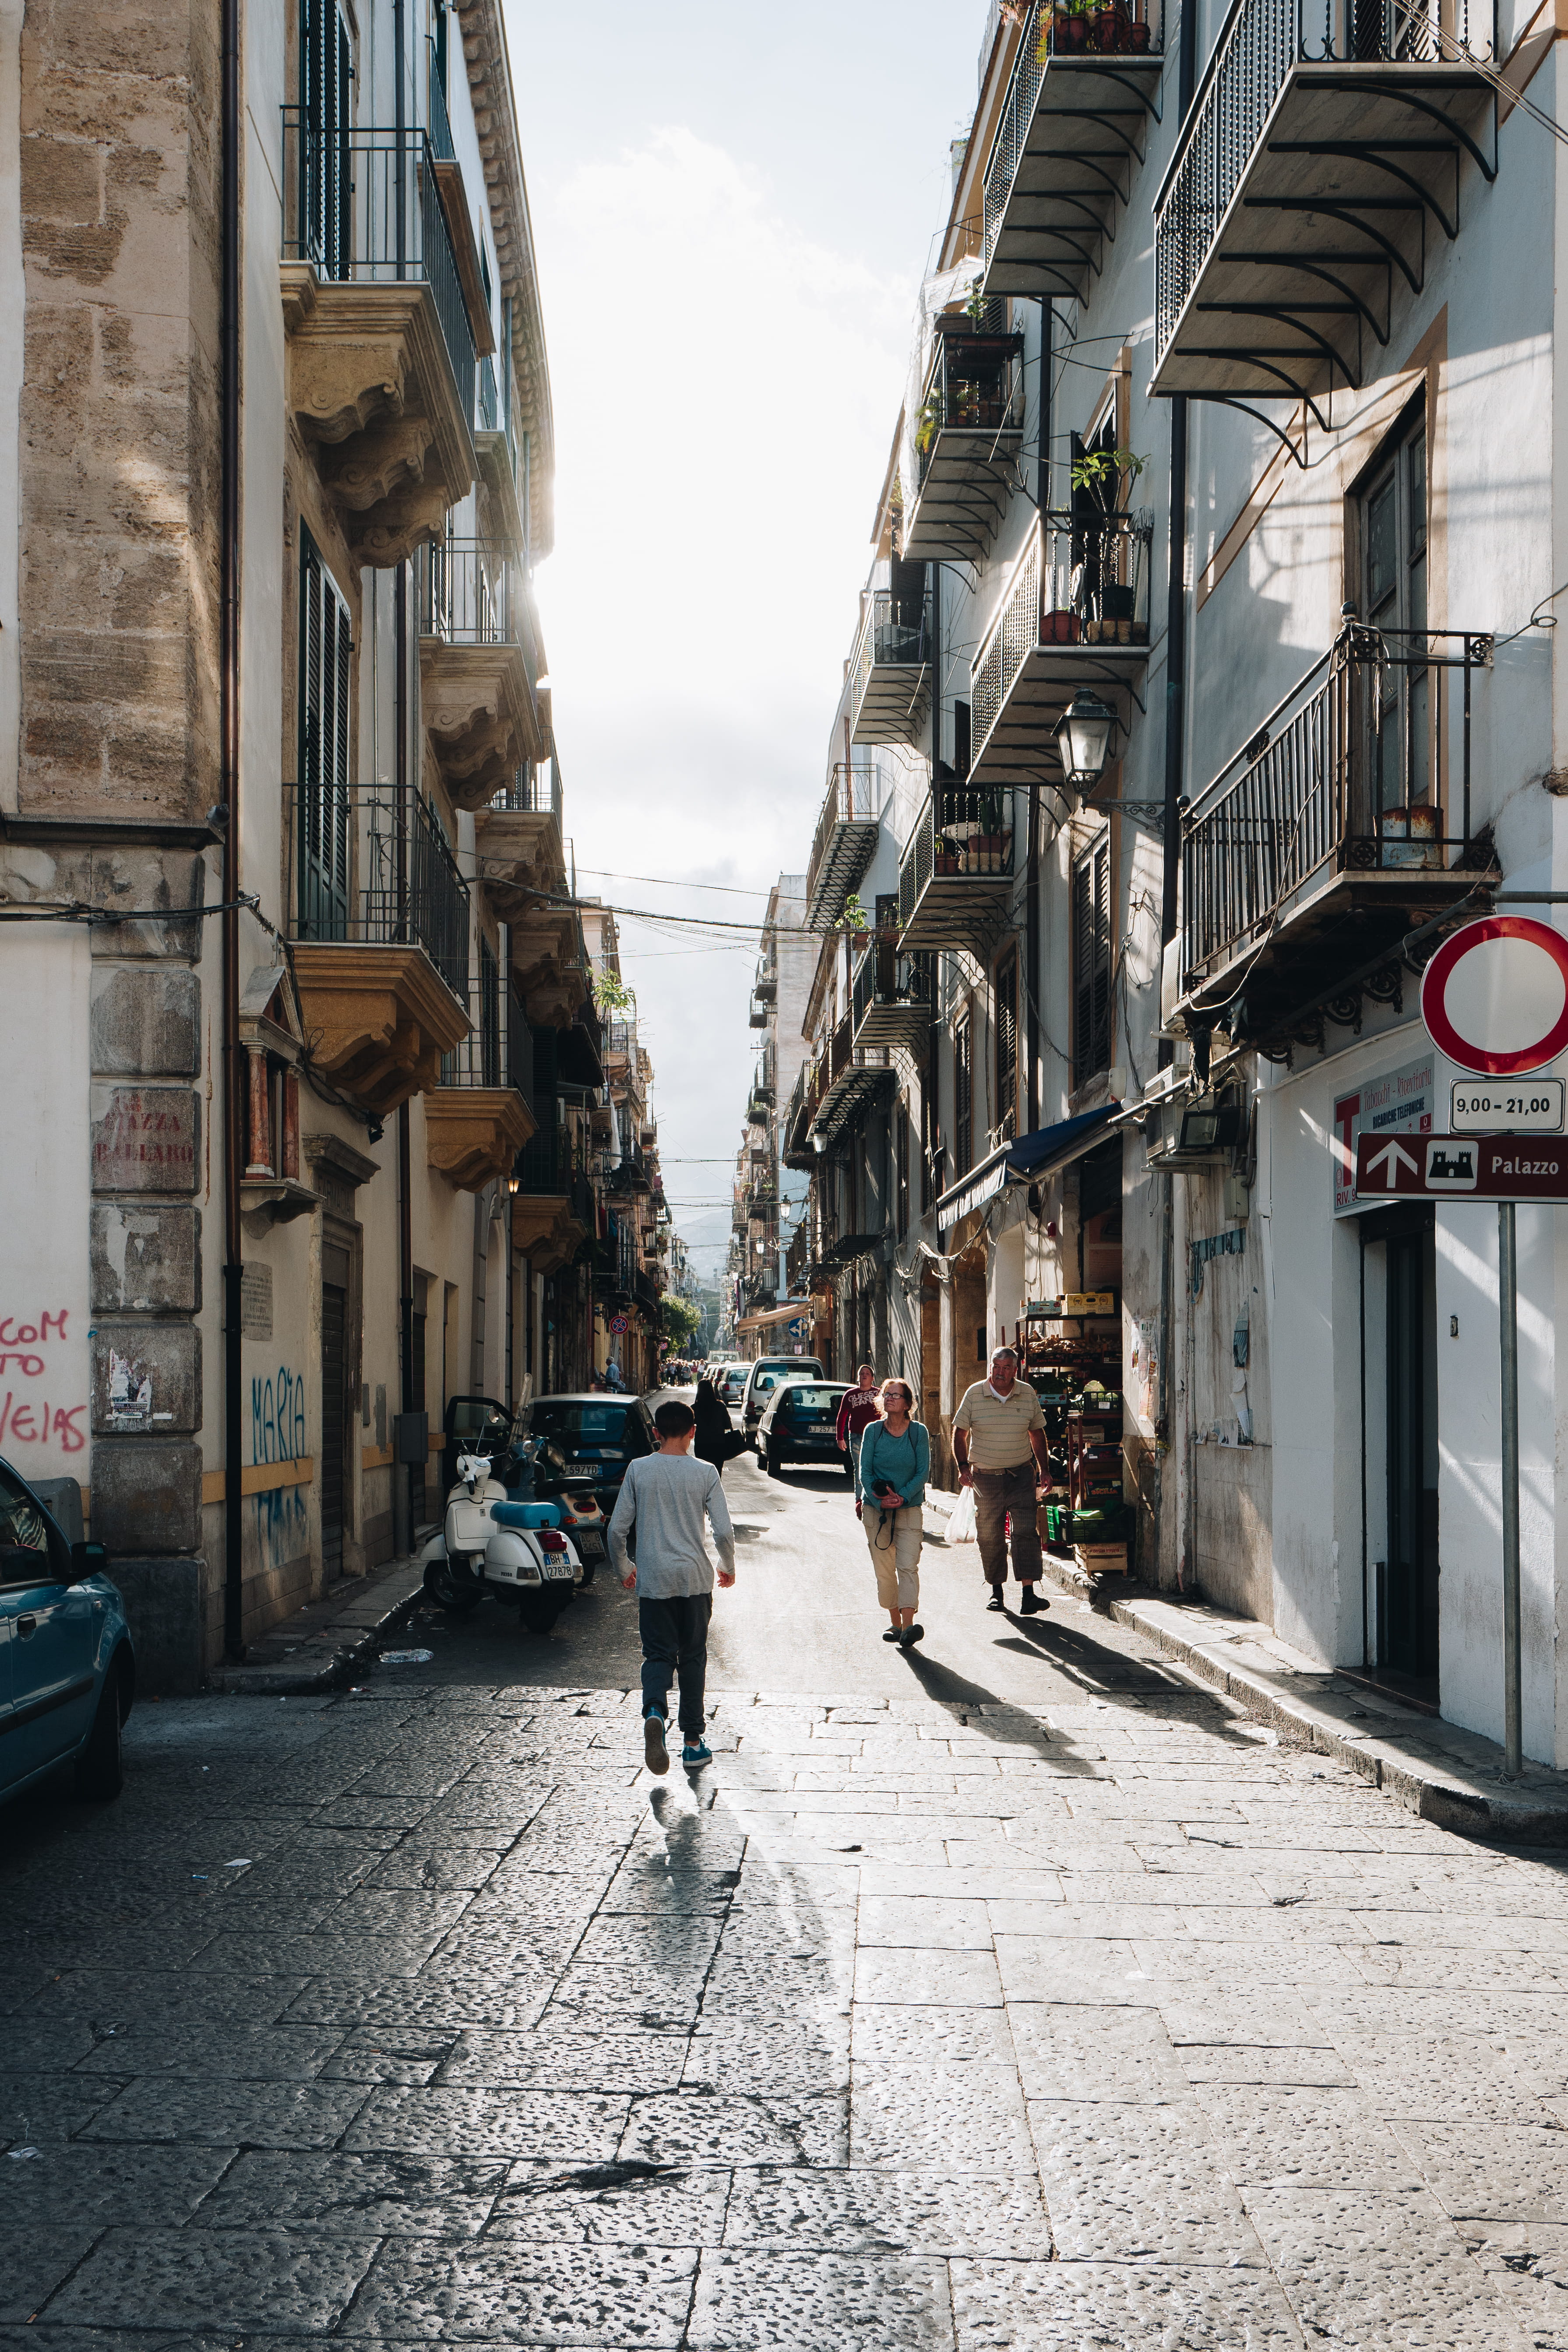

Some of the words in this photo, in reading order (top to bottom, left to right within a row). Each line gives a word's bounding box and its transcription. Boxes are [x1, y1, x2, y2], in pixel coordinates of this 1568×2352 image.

[1364, 1083, 1390, 1111] Tabacchi
[1397, 1067, 1431, 1098] Ricevitoria
[1373, 1108, 1396, 1130] RICARICHE
[1397, 1097, 1425, 1121] TELEFONICHE
[1456, 1098, 1490, 1115] 9,00
[1506, 1097, 1550, 1116] 21,00
[1492, 1156, 1559, 1174] Palazzo
[1336, 1190, 1350, 1206] RIV.
[570, 1465, 597, 1474] 597YD
[550, 1554, 560, 1564] BH
[548, 1566, 572, 1577] 27878
